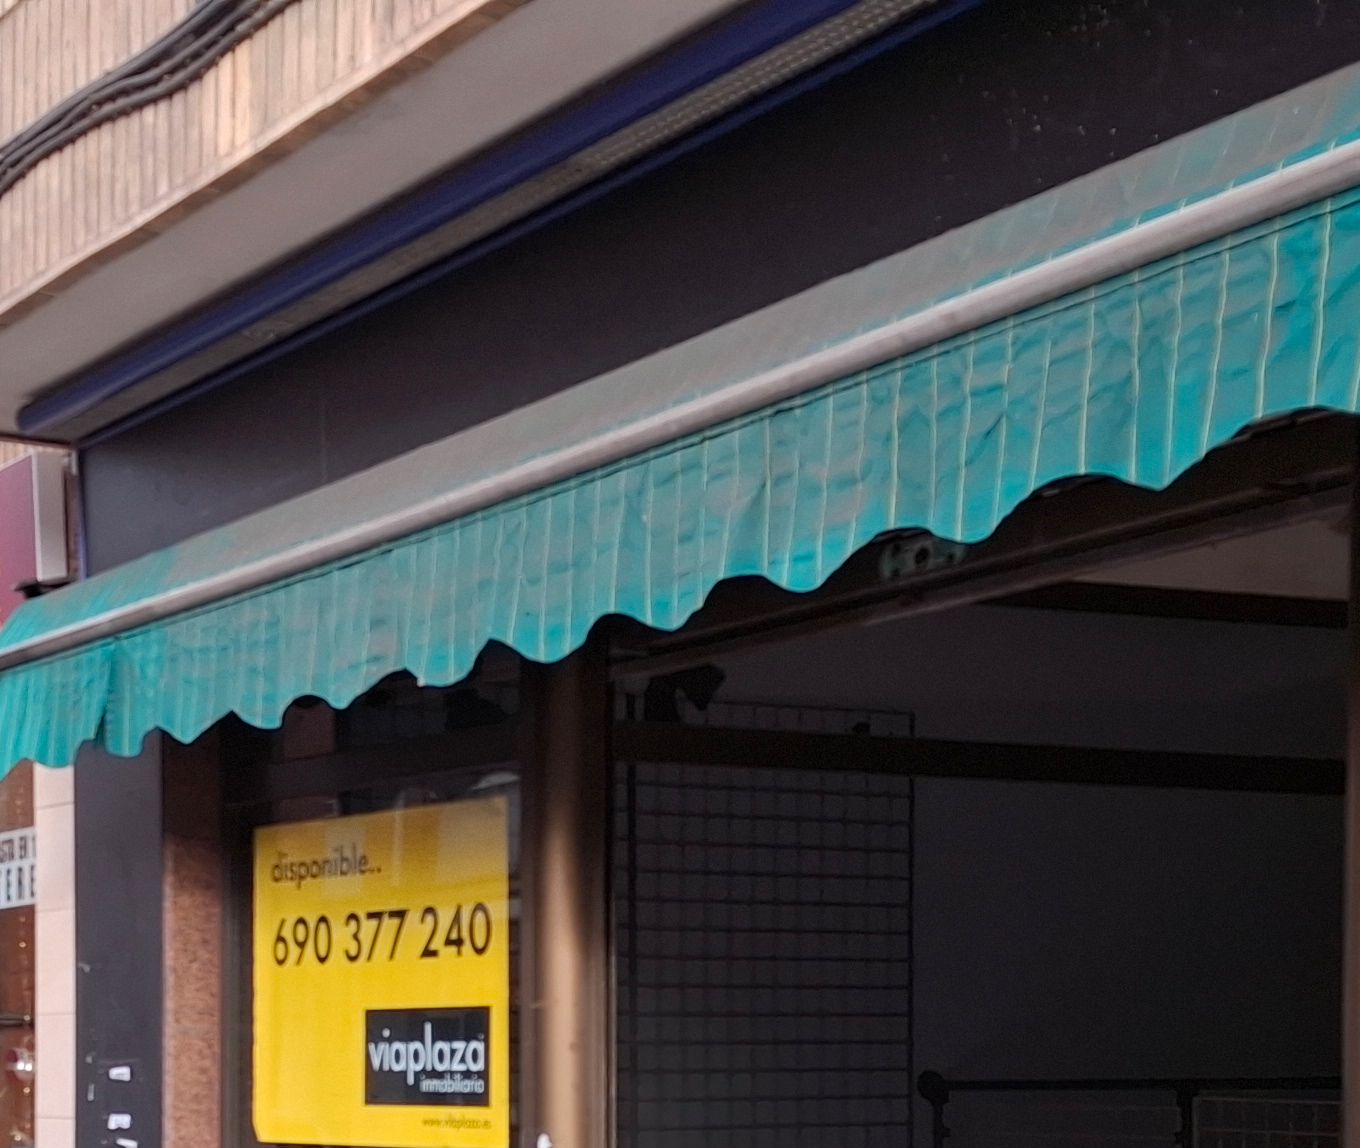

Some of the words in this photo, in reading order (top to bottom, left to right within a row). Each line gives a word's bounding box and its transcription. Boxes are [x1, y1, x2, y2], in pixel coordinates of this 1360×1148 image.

[273, 914, 333, 967] 690
[344, 908, 410, 963] 377
[418, 902, 492, 959] 240
[368, 1021, 485, 1086] viaplaza
[420, 1073, 485, 1093] inmobiliaria
